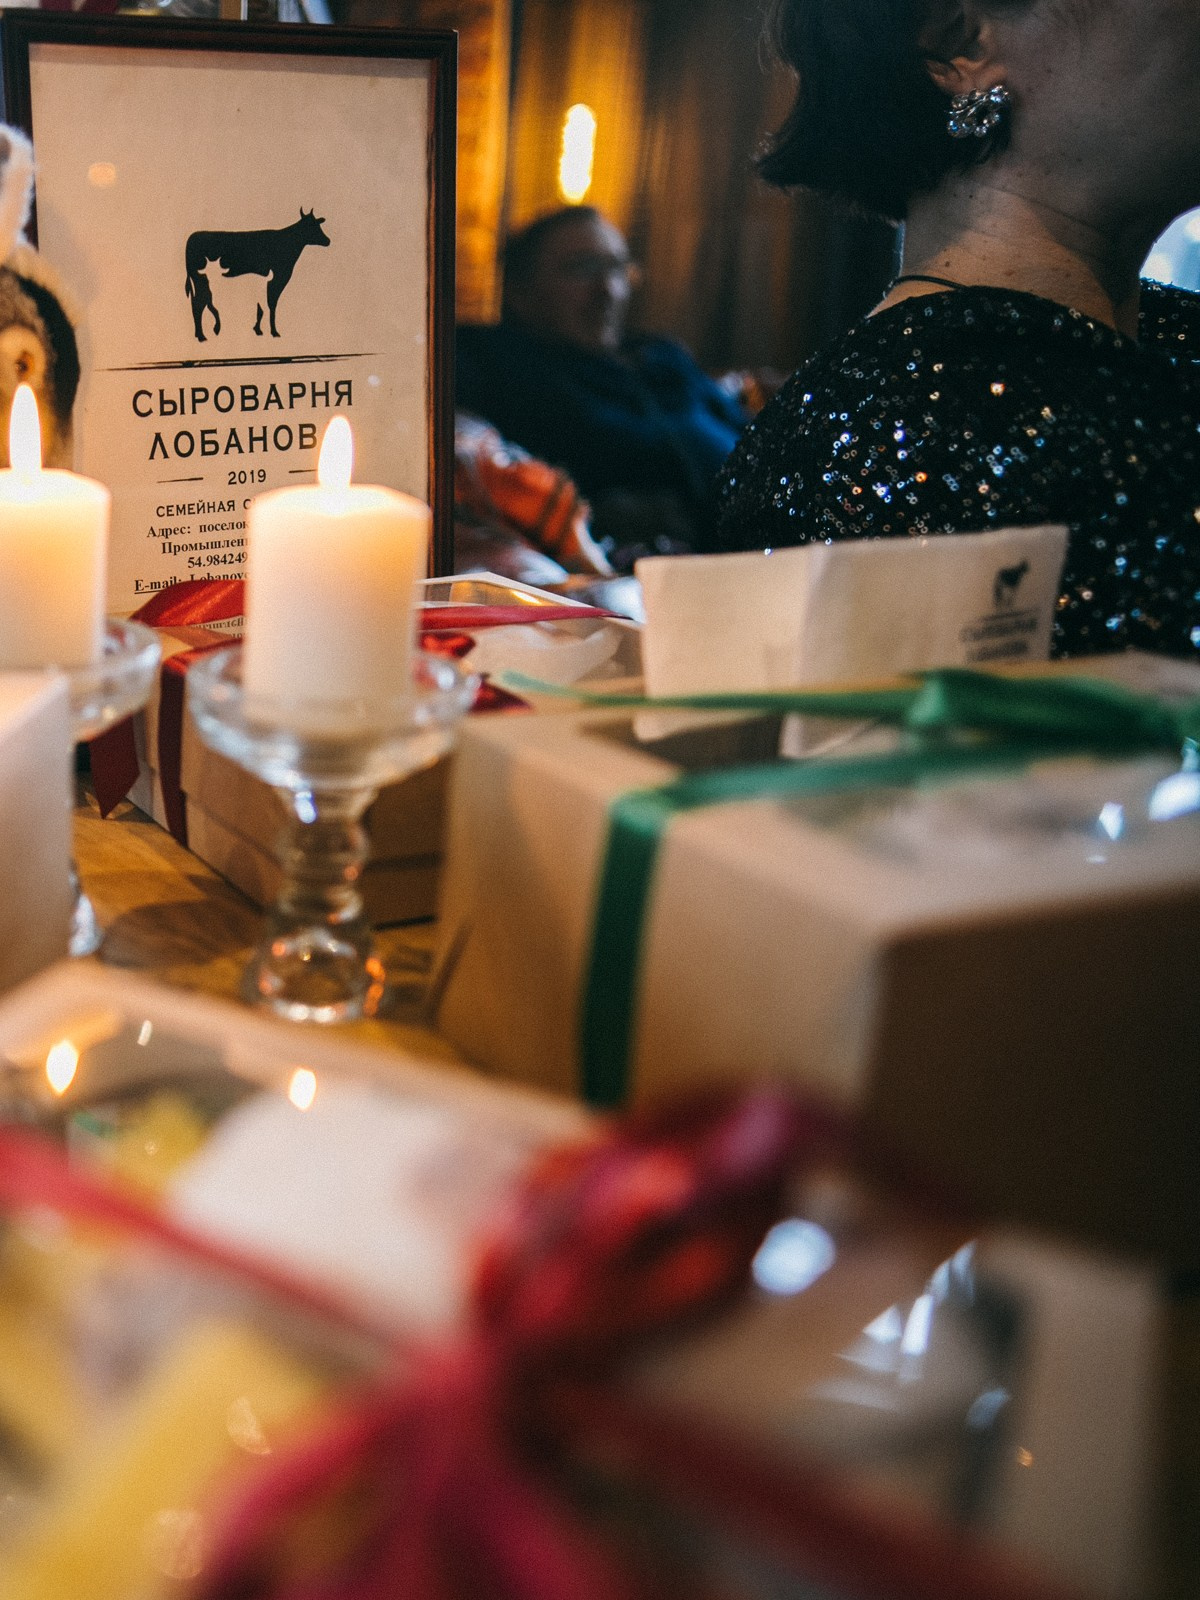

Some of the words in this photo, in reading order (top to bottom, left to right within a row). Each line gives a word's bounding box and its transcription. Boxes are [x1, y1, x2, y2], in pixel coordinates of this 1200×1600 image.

[132, 380, 353, 418] СЫРОВАРНЯ
[148, 423, 318, 461] ЛОБАНОВ
[227, 469, 267, 485] 2019
[156, 500, 236, 518] СЕМЕЙНАЯ
[146, 525, 192, 539] Адрес:
